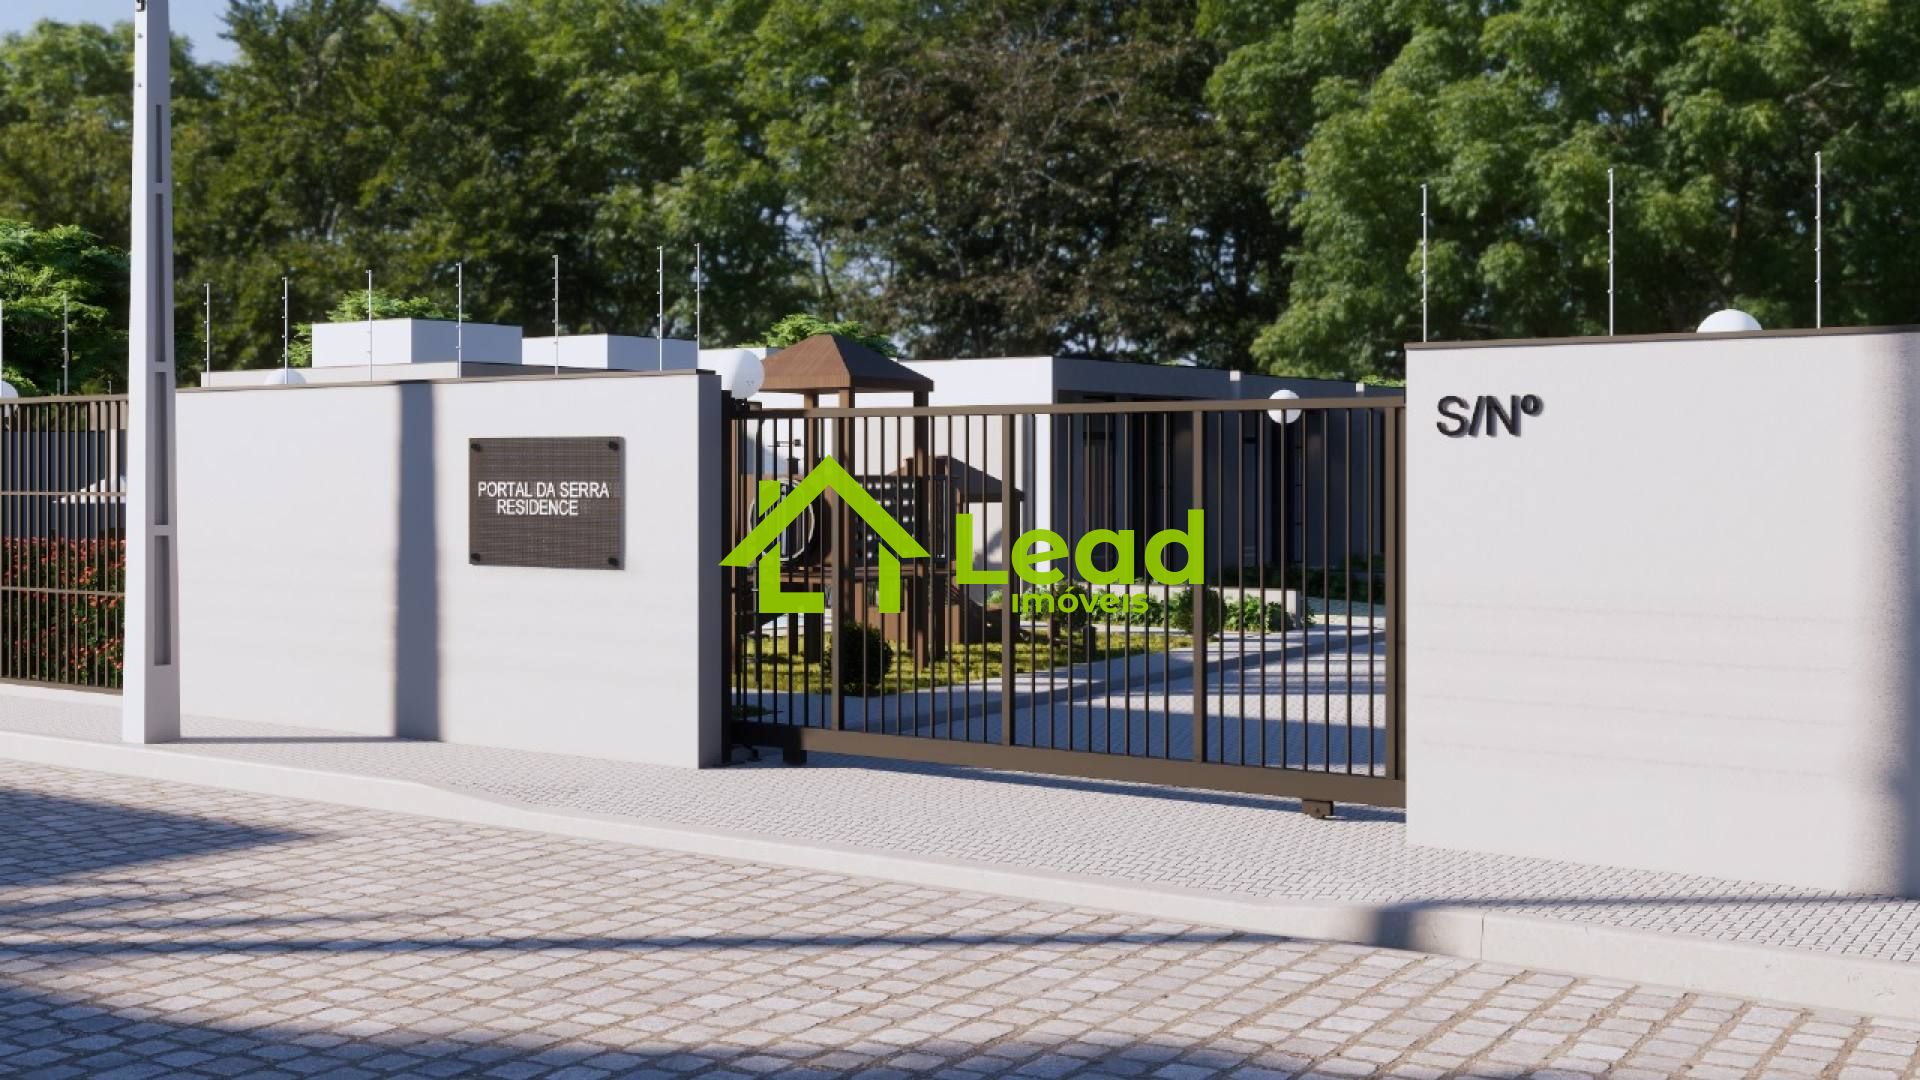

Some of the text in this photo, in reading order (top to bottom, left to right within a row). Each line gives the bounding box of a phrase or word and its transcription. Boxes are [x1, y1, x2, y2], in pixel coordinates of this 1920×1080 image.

[478, 481, 610, 499] PORTAL DA SERRA
[497, 498, 579, 516] RESIDENCE
